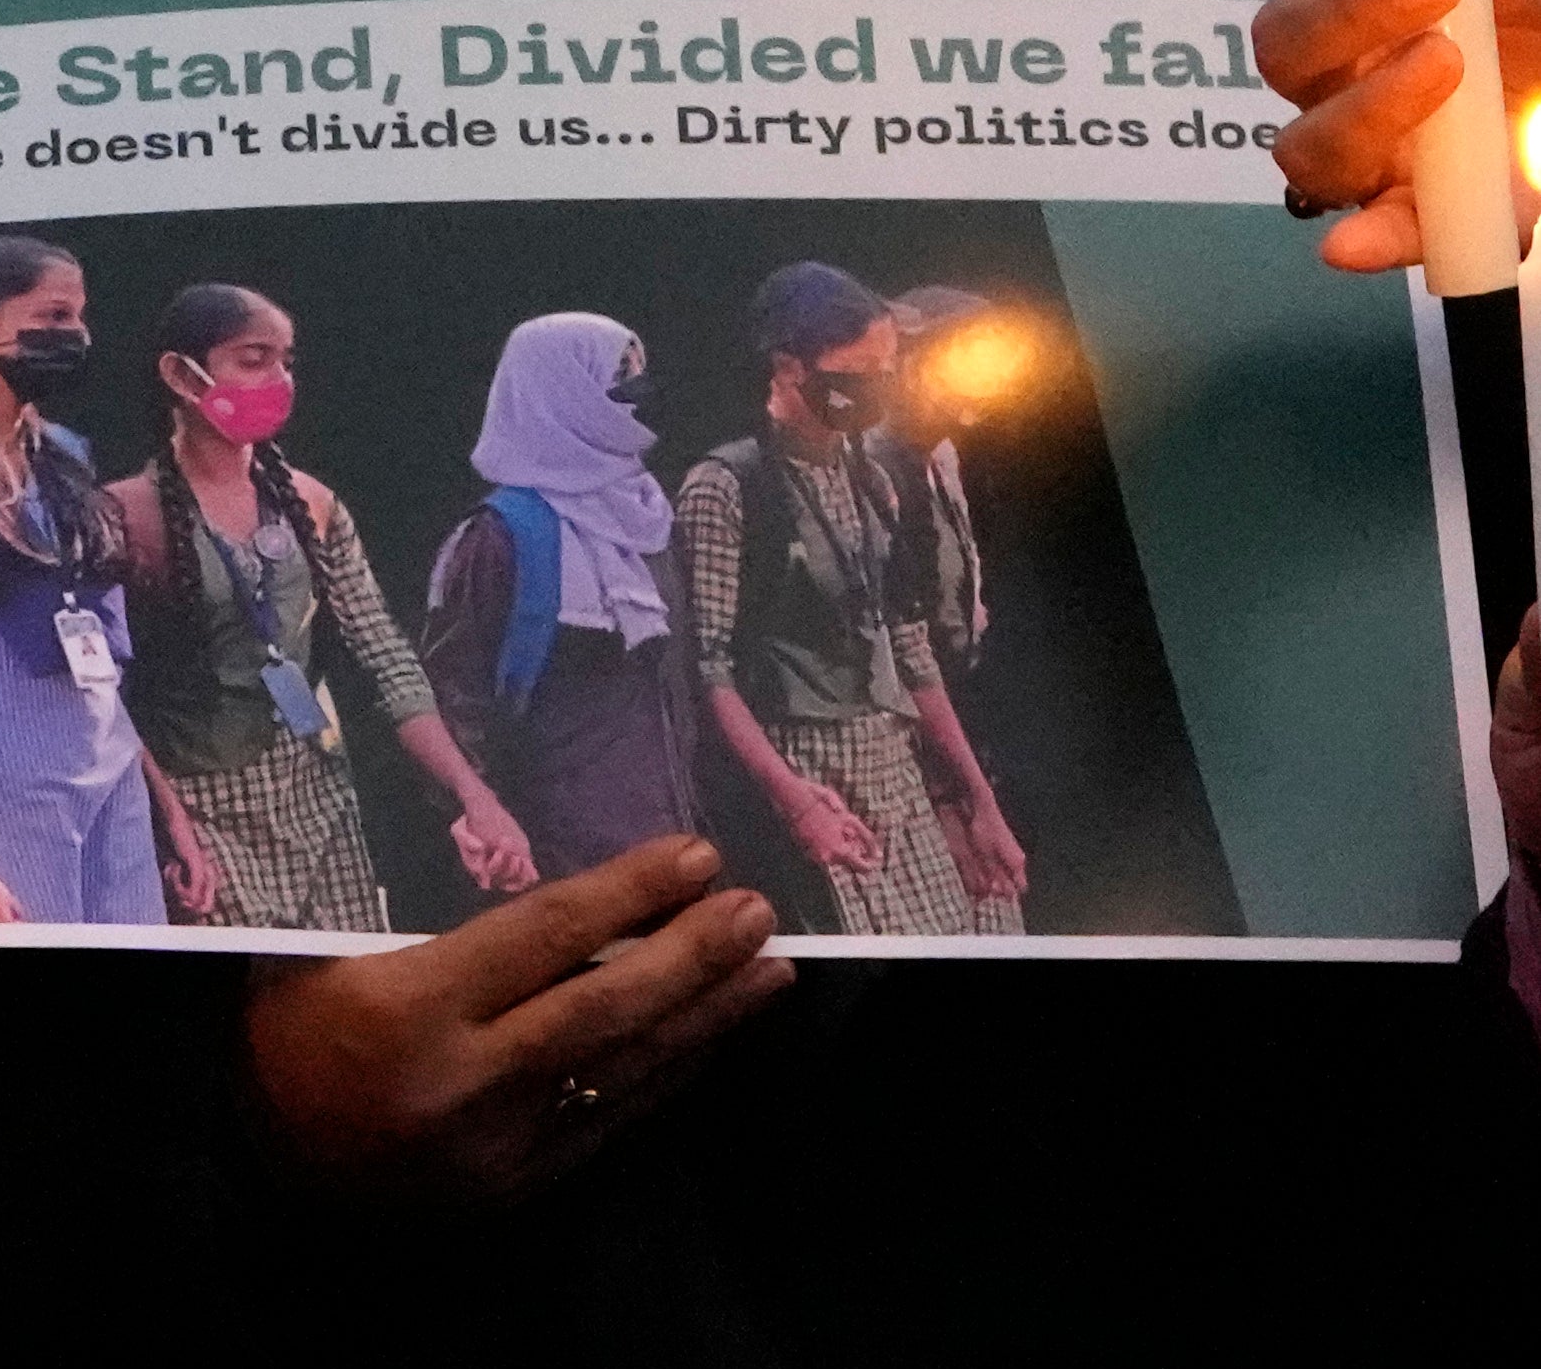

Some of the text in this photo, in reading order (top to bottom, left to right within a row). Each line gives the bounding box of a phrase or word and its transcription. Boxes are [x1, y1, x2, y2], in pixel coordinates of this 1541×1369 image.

[55, 25, 403, 107] Stand,
[440, 17, 878, 88] Divided
[909, 31, 1066, 86] we
[1096, 19, 1264, 90] fal
[24, 115, 261, 173] doesn't
[280, 109, 499, 152] divide
[519, 112, 654, 149] us...
[678, 105, 849, 156] Dirty
[874, 103, 1150, 155] politics
[1168, 109, 1282, 150] doe
